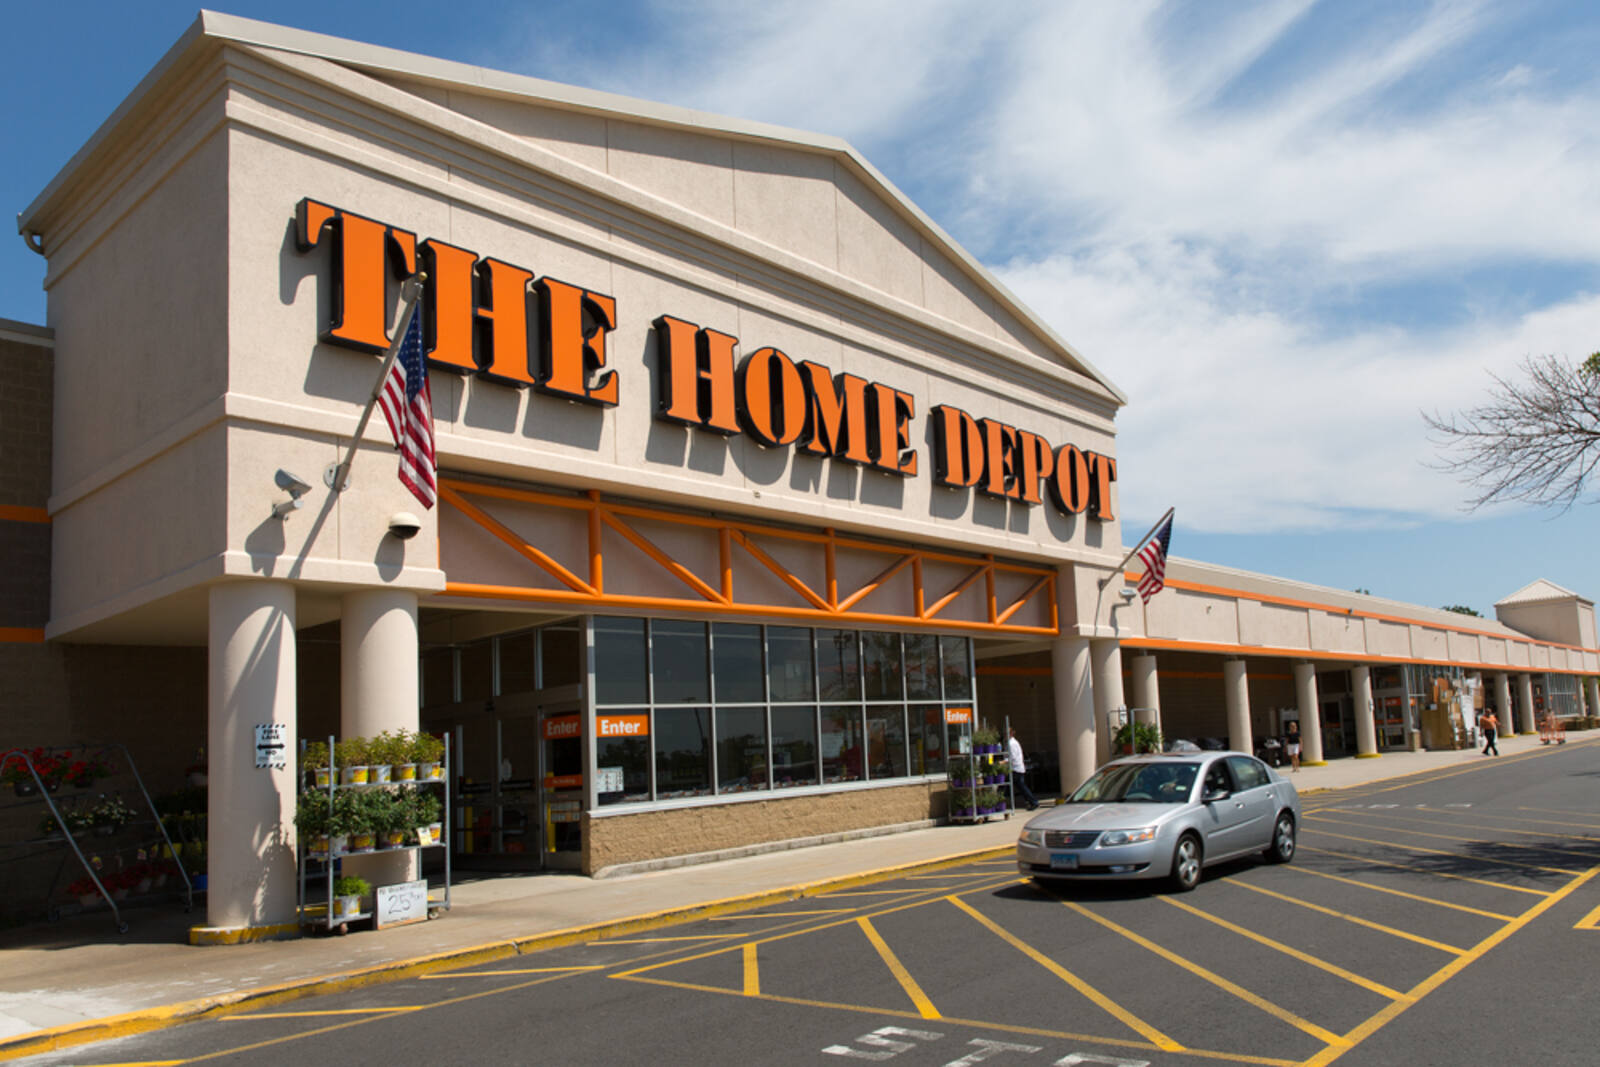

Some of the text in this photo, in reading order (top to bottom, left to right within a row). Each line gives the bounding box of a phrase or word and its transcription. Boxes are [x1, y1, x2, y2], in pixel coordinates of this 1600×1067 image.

[297, 197, 1117, 521] THE HOME DEPOT
[946, 709, 969, 722] Enter
[546, 720, 579, 736] Enter
[600, 719, 640, 735] Enter
